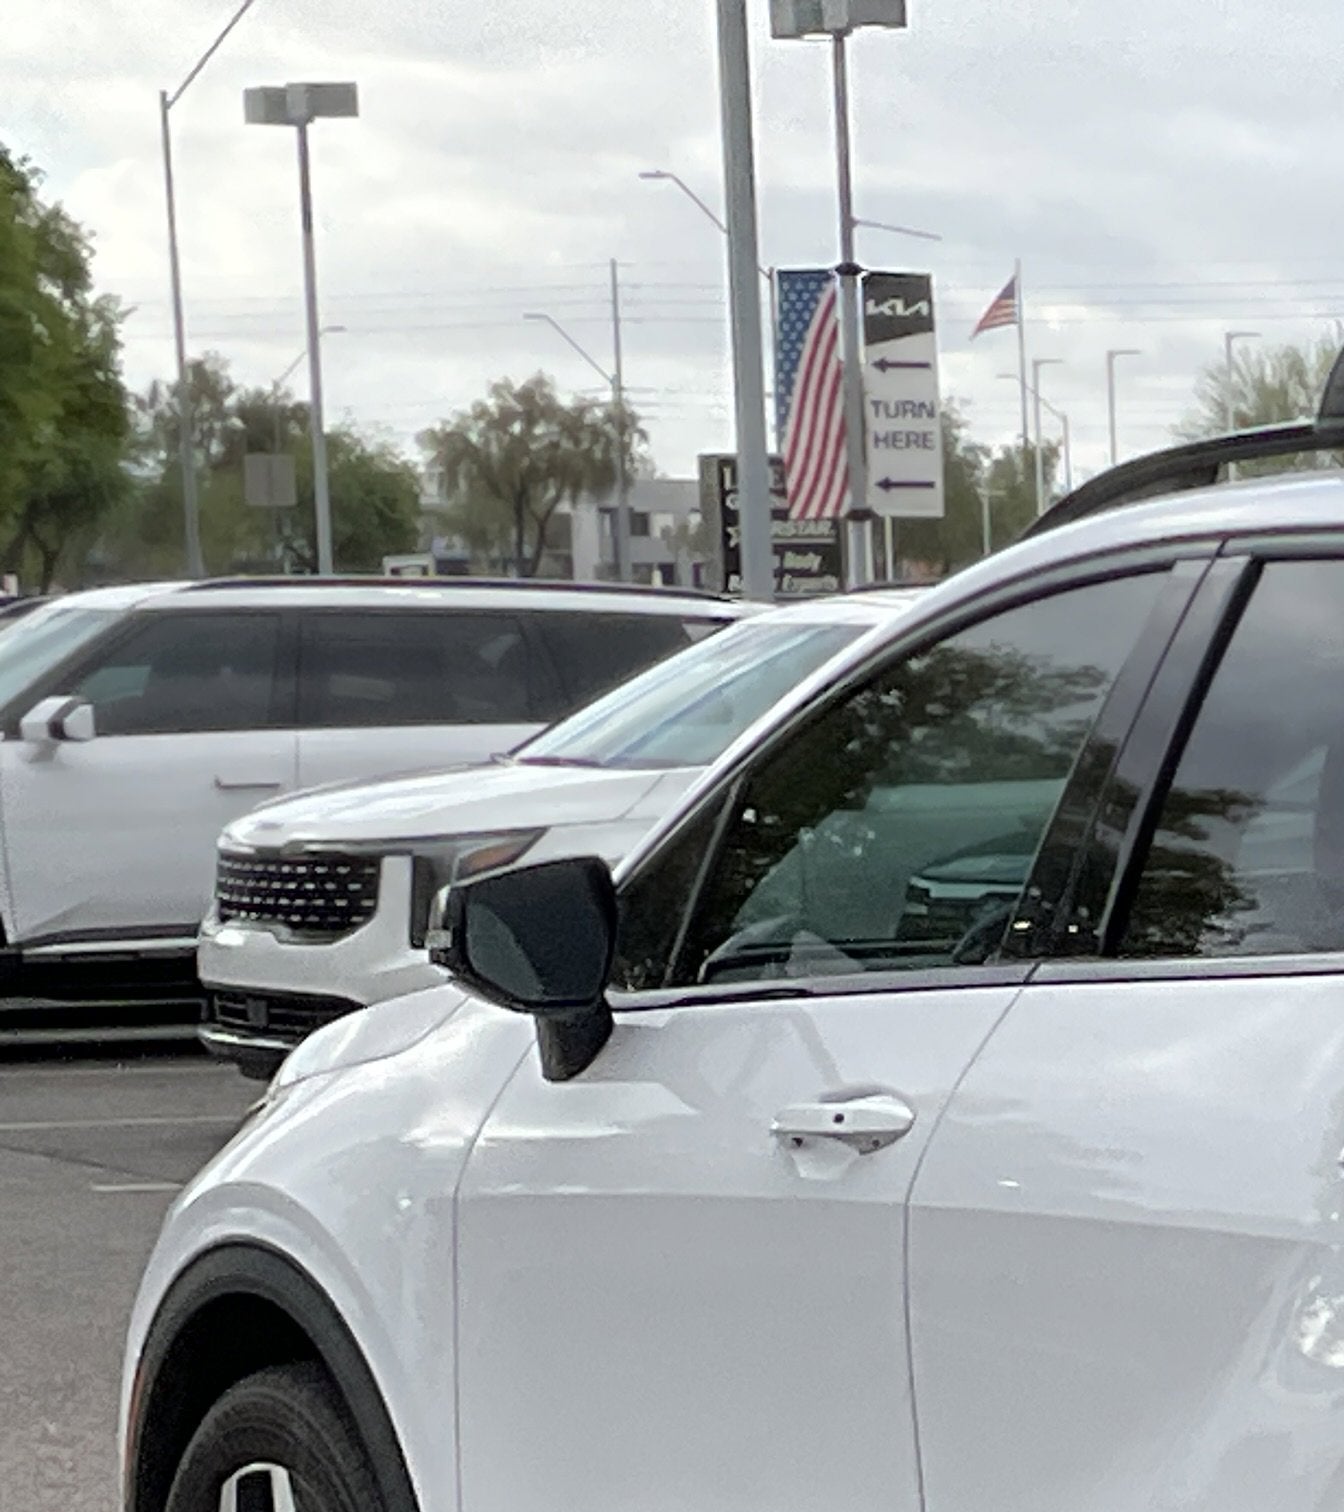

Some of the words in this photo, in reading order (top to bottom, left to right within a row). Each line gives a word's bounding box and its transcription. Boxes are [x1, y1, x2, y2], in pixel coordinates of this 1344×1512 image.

[865, 298, 930, 317] KIA
[870, 399, 936, 419] TURN
[873, 430, 936, 451] HERE
